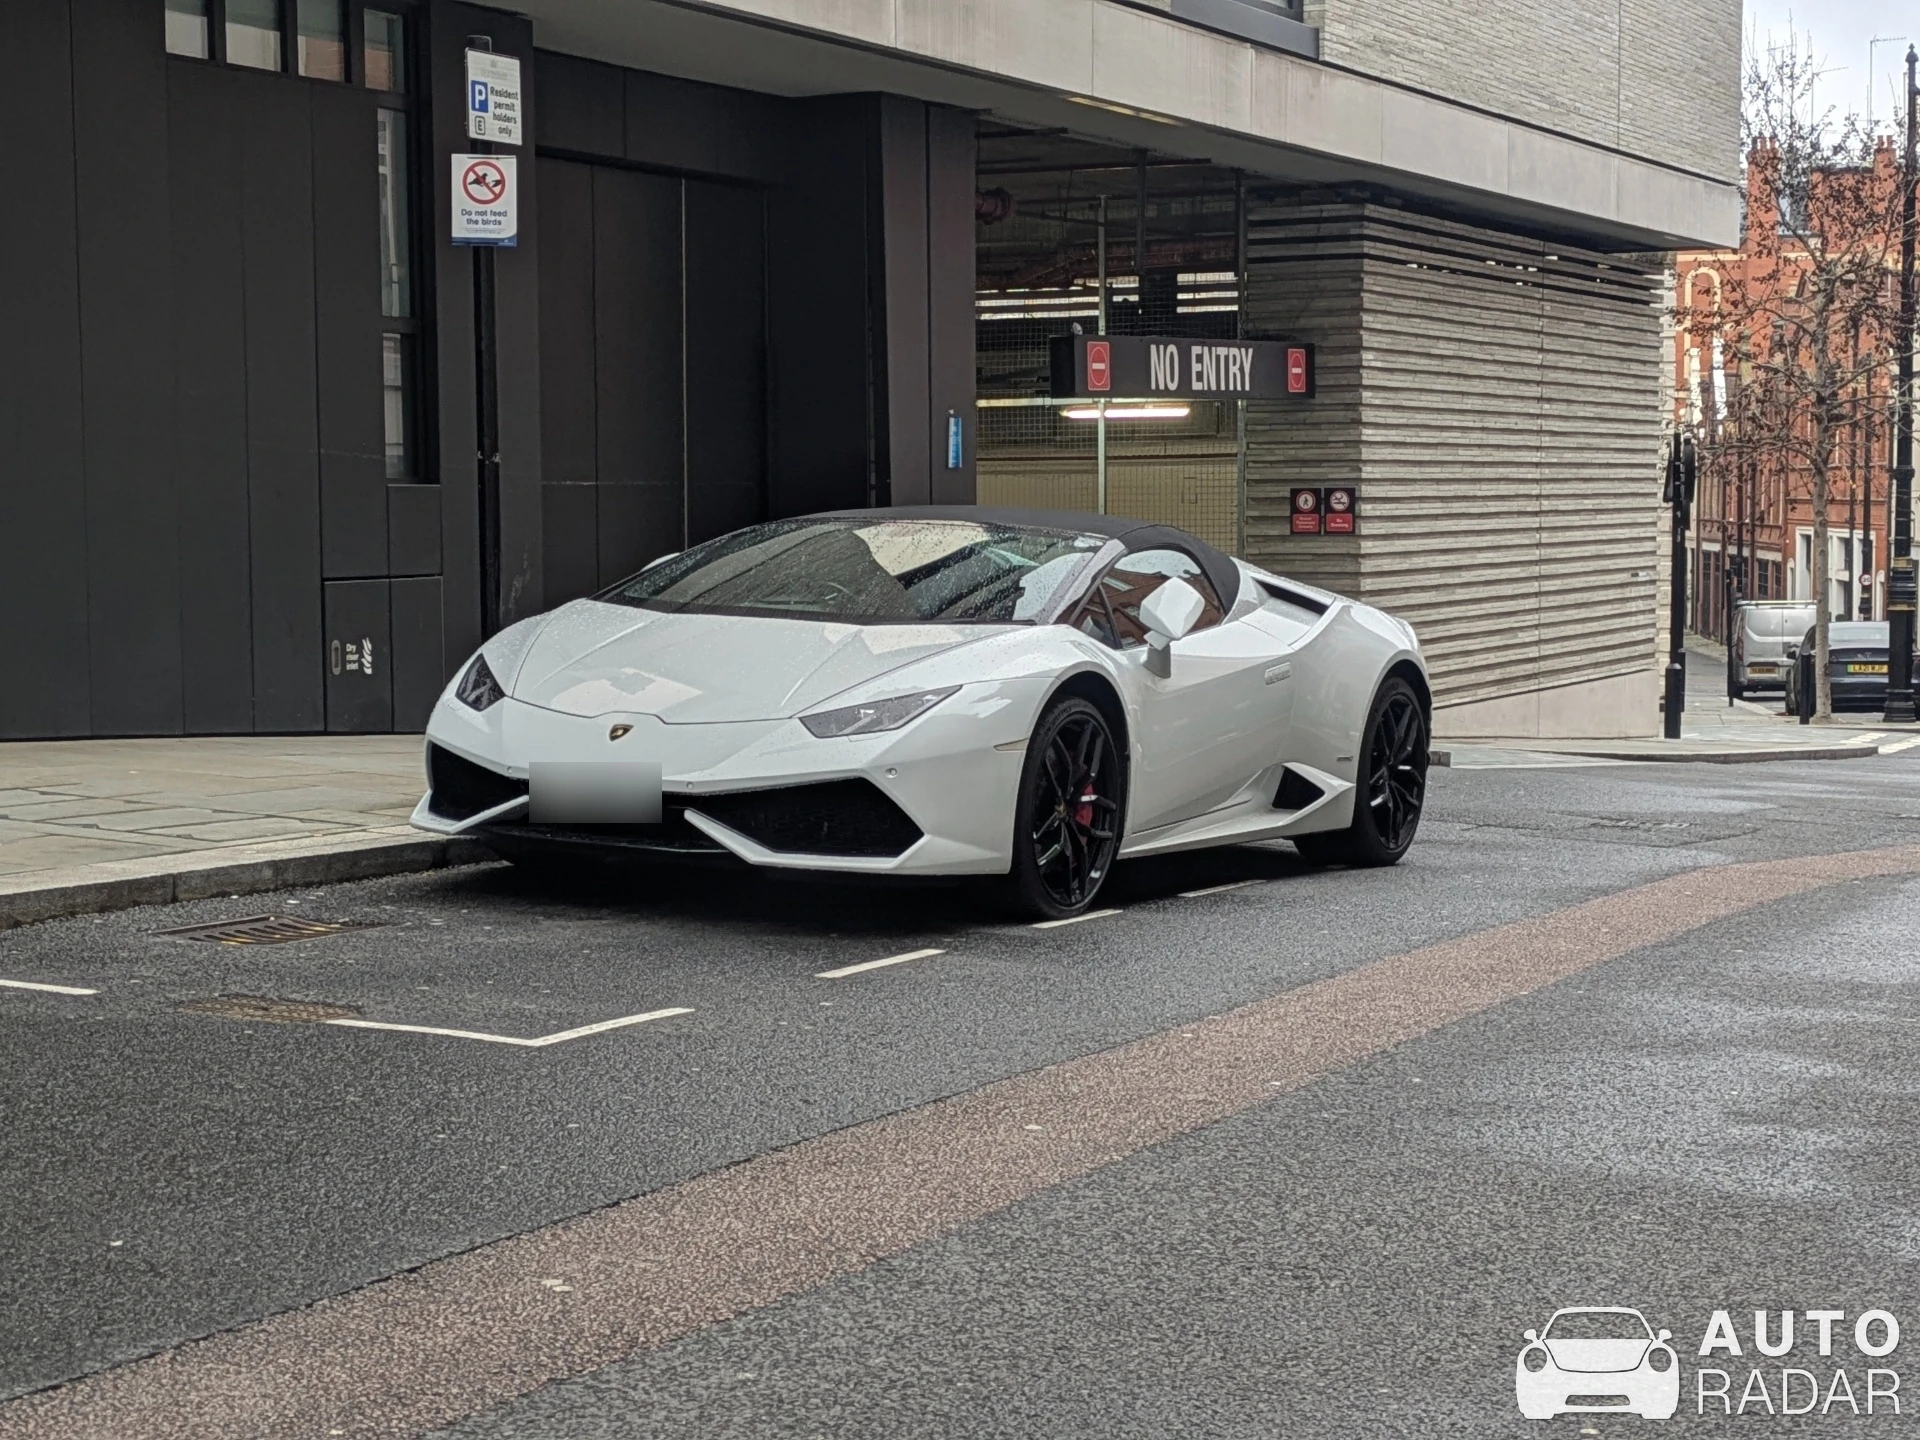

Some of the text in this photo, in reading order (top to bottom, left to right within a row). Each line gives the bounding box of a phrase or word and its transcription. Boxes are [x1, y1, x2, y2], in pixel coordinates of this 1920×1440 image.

[475, 84, 486, 109] P
[490, 86, 519, 100] Resident
[494, 101, 515, 112] permit
[493, 111, 517, 124] holders
[477, 119, 483, 131] E
[498, 125, 512, 137] only
[461, 208, 508, 217] Do not feed
[481, 218, 502, 226] birds
[1150, 343, 1253, 391] NO ENTRY
[346, 643, 357, 653] Dry
